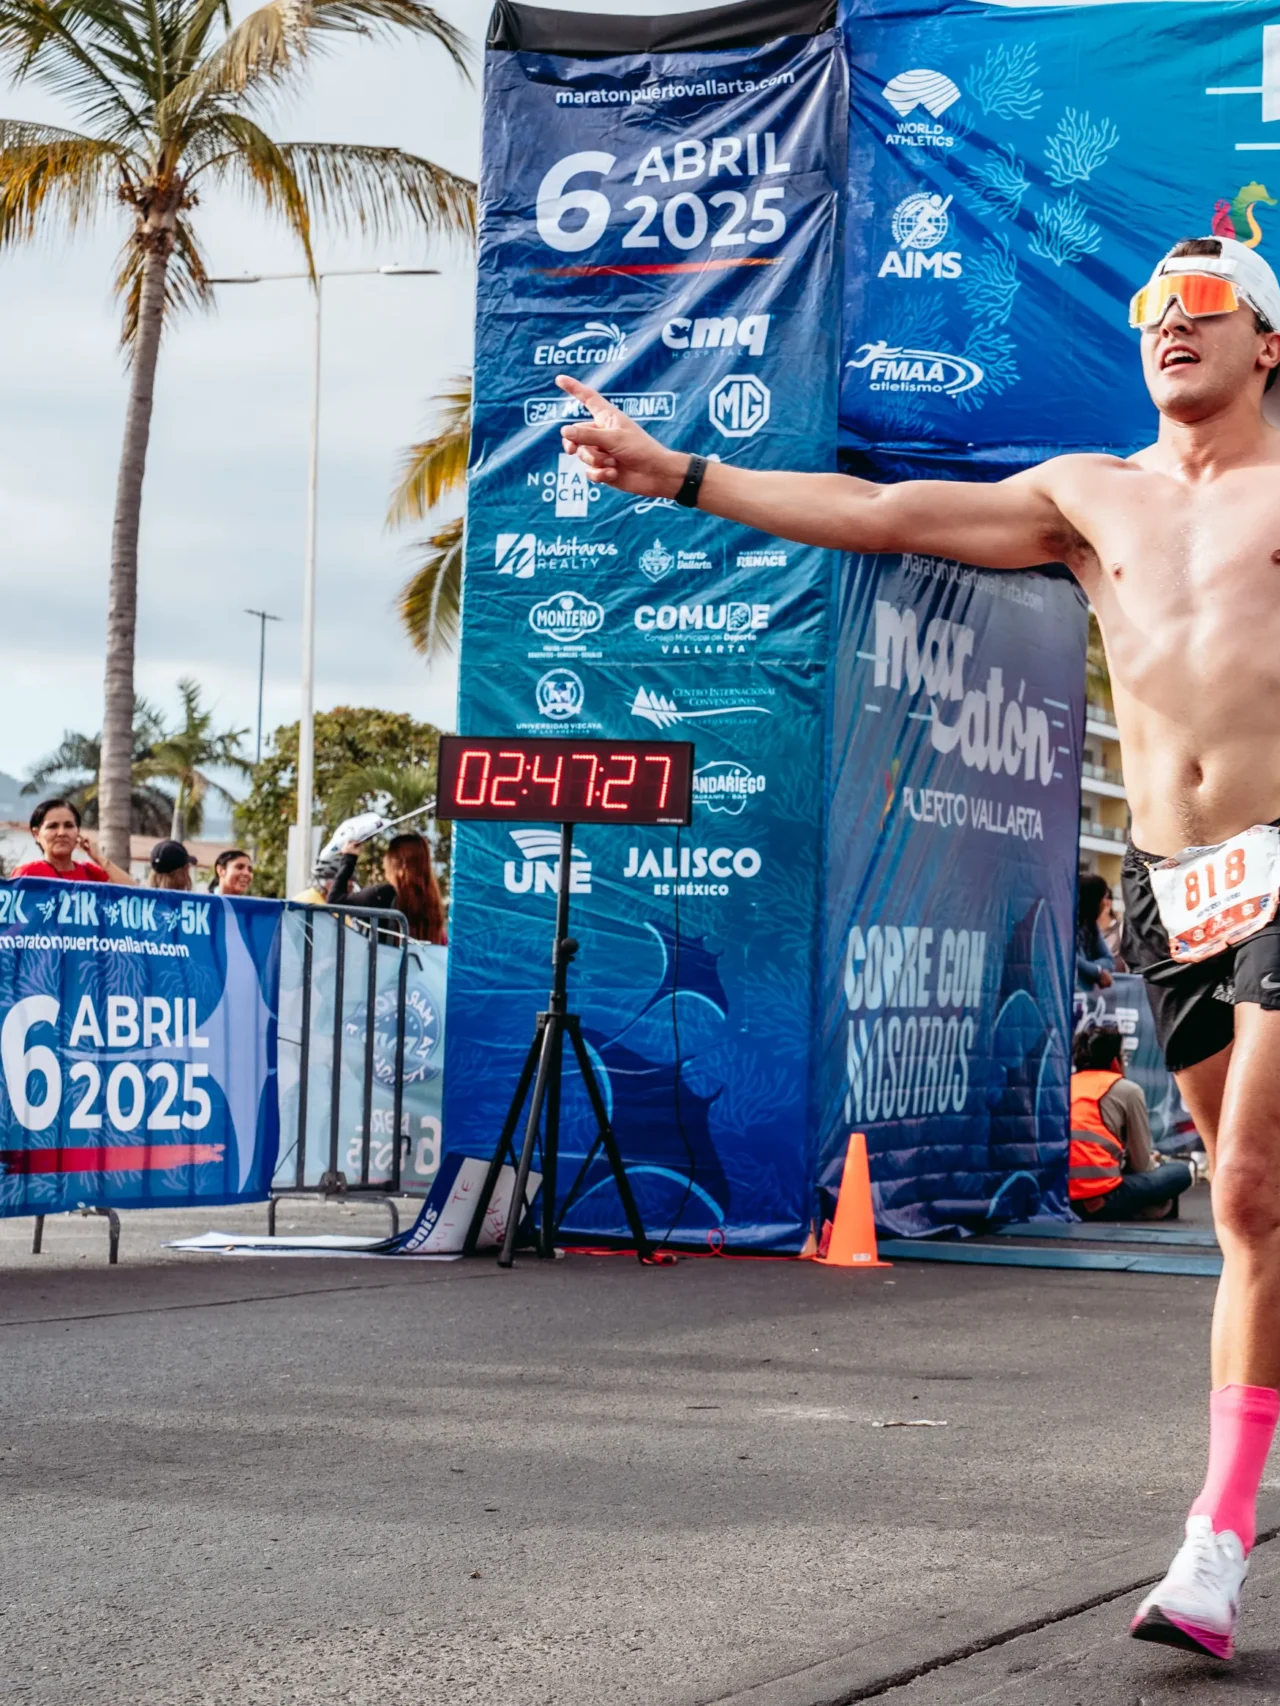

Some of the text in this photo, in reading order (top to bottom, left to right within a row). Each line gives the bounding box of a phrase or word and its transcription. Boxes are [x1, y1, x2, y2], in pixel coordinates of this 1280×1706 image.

[556, 71, 795, 104] maratonpuertovallarta.com
[885, 134, 954, 147] ATHLETICS
[896, 122, 944, 135] WORLD
[633, 132, 790, 186] ABRIL
[536, 151, 617, 253] 6
[622, 187, 787, 250] 2025
[877, 251, 963, 279] AIMS
[662, 314, 770, 356] cmq
[534, 344, 629, 365] Electrolit
[672, 349, 743, 359] HOSPITAL
[870, 360, 945, 381] FMAA
[869, 381, 943, 392] atletismo
[717, 383, 763, 429] MG
[542, 487, 600, 502] OCHO
[537, 535, 618, 556] habitares
[537, 558, 599, 569] REALTY
[736, 556, 787, 568] RENACE
[537, 610, 597, 627] MONTERO
[634, 602, 770, 631] COMUDE
[662, 645, 745, 654] VALLARTA
[456, 751, 671, 809] 02:47:27
[903, 786, 1043, 841] PUERTO VALLARTA
[504, 861, 592, 893] UNE
[624, 847, 762, 878] JALISCO
[654, 882, 729, 895] ES MÉXICO
[1185, 848, 1246, 911] 818
[57, 890, 99, 926] 21K
[118, 896, 158, 931] 10K
[181, 901, 211, 935] 5K
[0, 933, 189, 957] maratonpuertovallarta.com
[937, 928, 987, 1008] CON
[69, 996, 210, 1048] ABRIL
[1, 995, 63, 1131] 6
[845, 1015, 974, 1124] NOSOTROS
[69, 1061, 212, 1131] 2025
